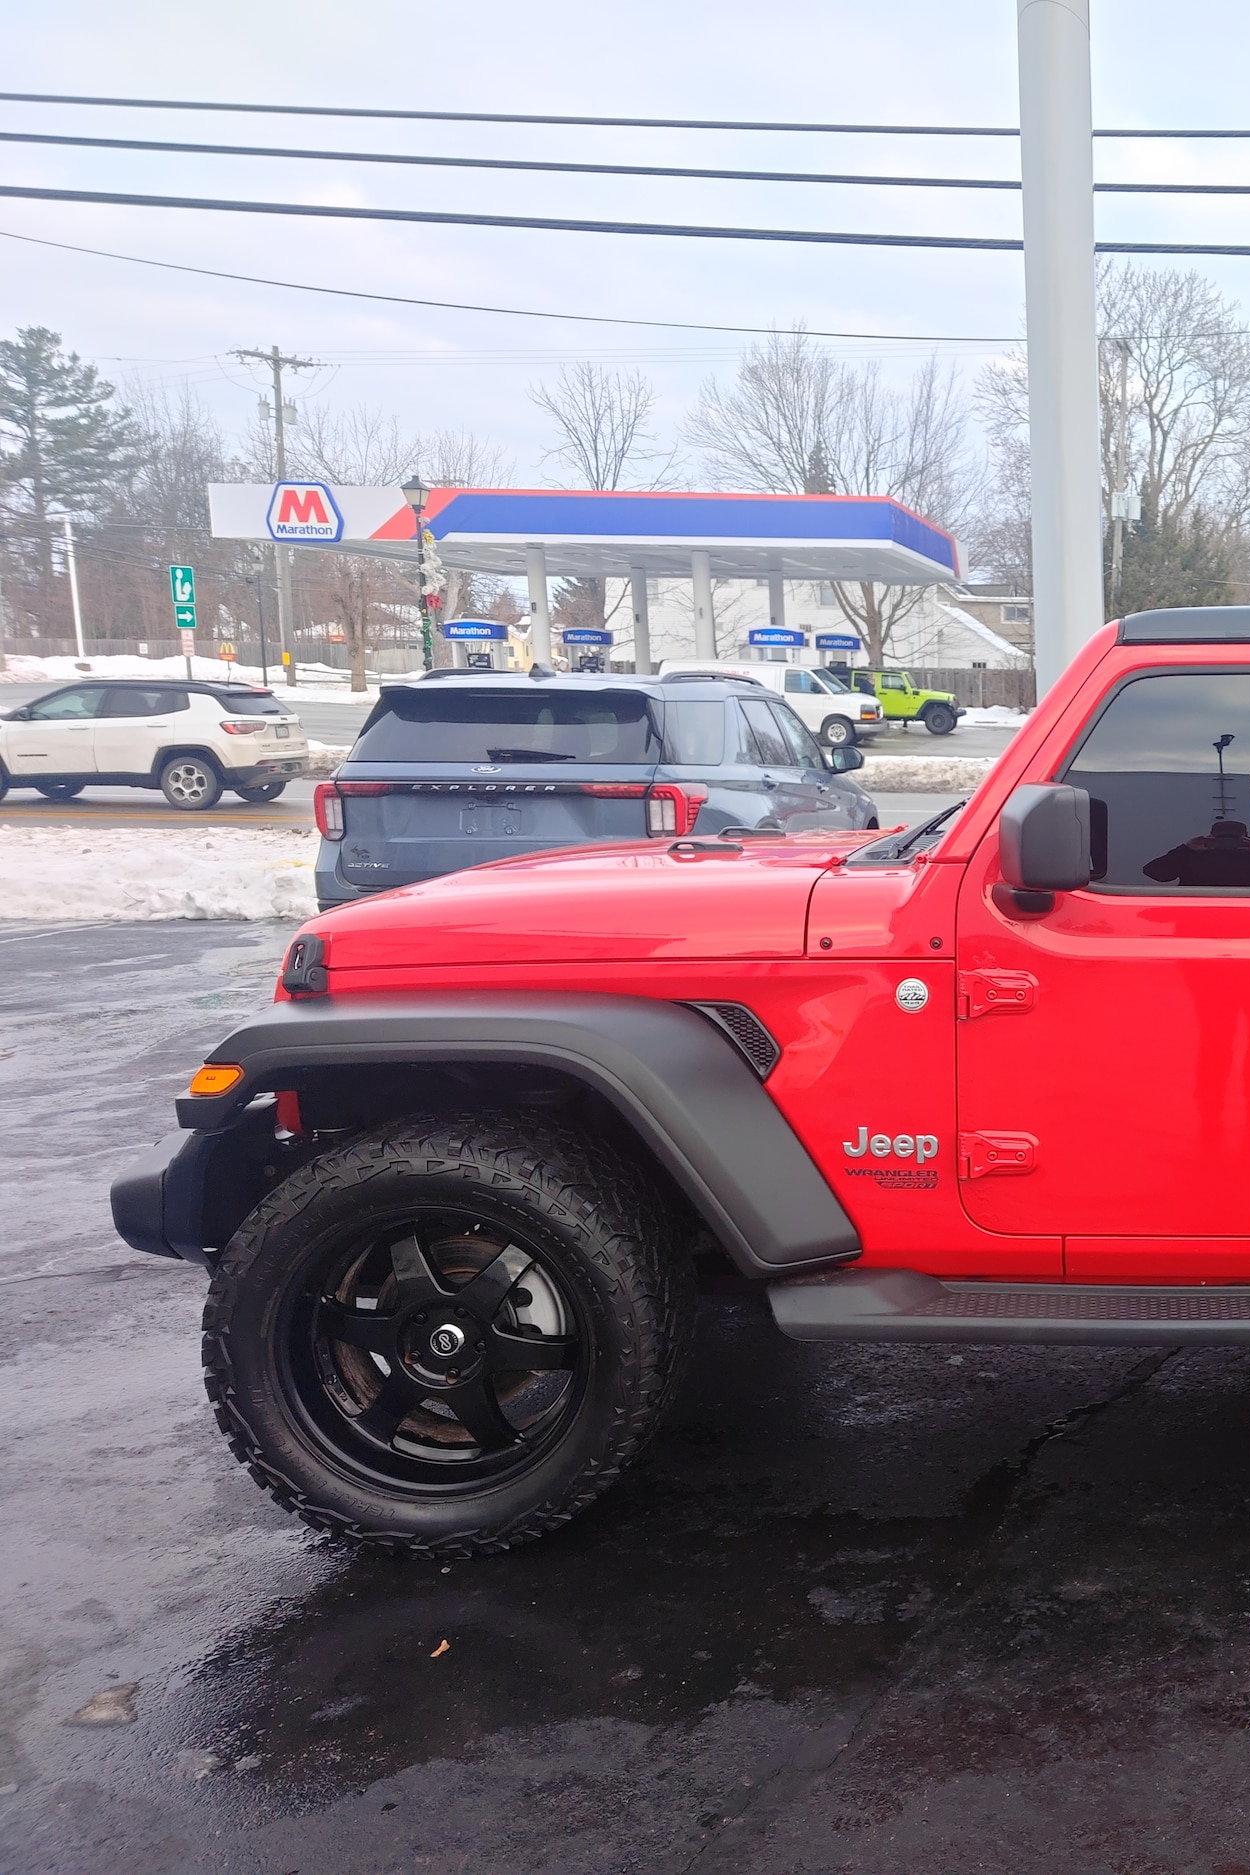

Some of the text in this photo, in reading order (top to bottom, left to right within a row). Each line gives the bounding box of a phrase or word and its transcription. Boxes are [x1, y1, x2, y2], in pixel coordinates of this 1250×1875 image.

[277, 489, 330, 523] M
[276, 524, 332, 535] Marathon
[449, 626, 491, 636] Marathon
[566, 633, 602, 642] Marathon
[753, 633, 794, 642] Marathon
[819, 638, 854, 647] Marathon
[842, 1126, 939, 1164] Jeep
[845, 1168, 938, 1177] WRANGLER
